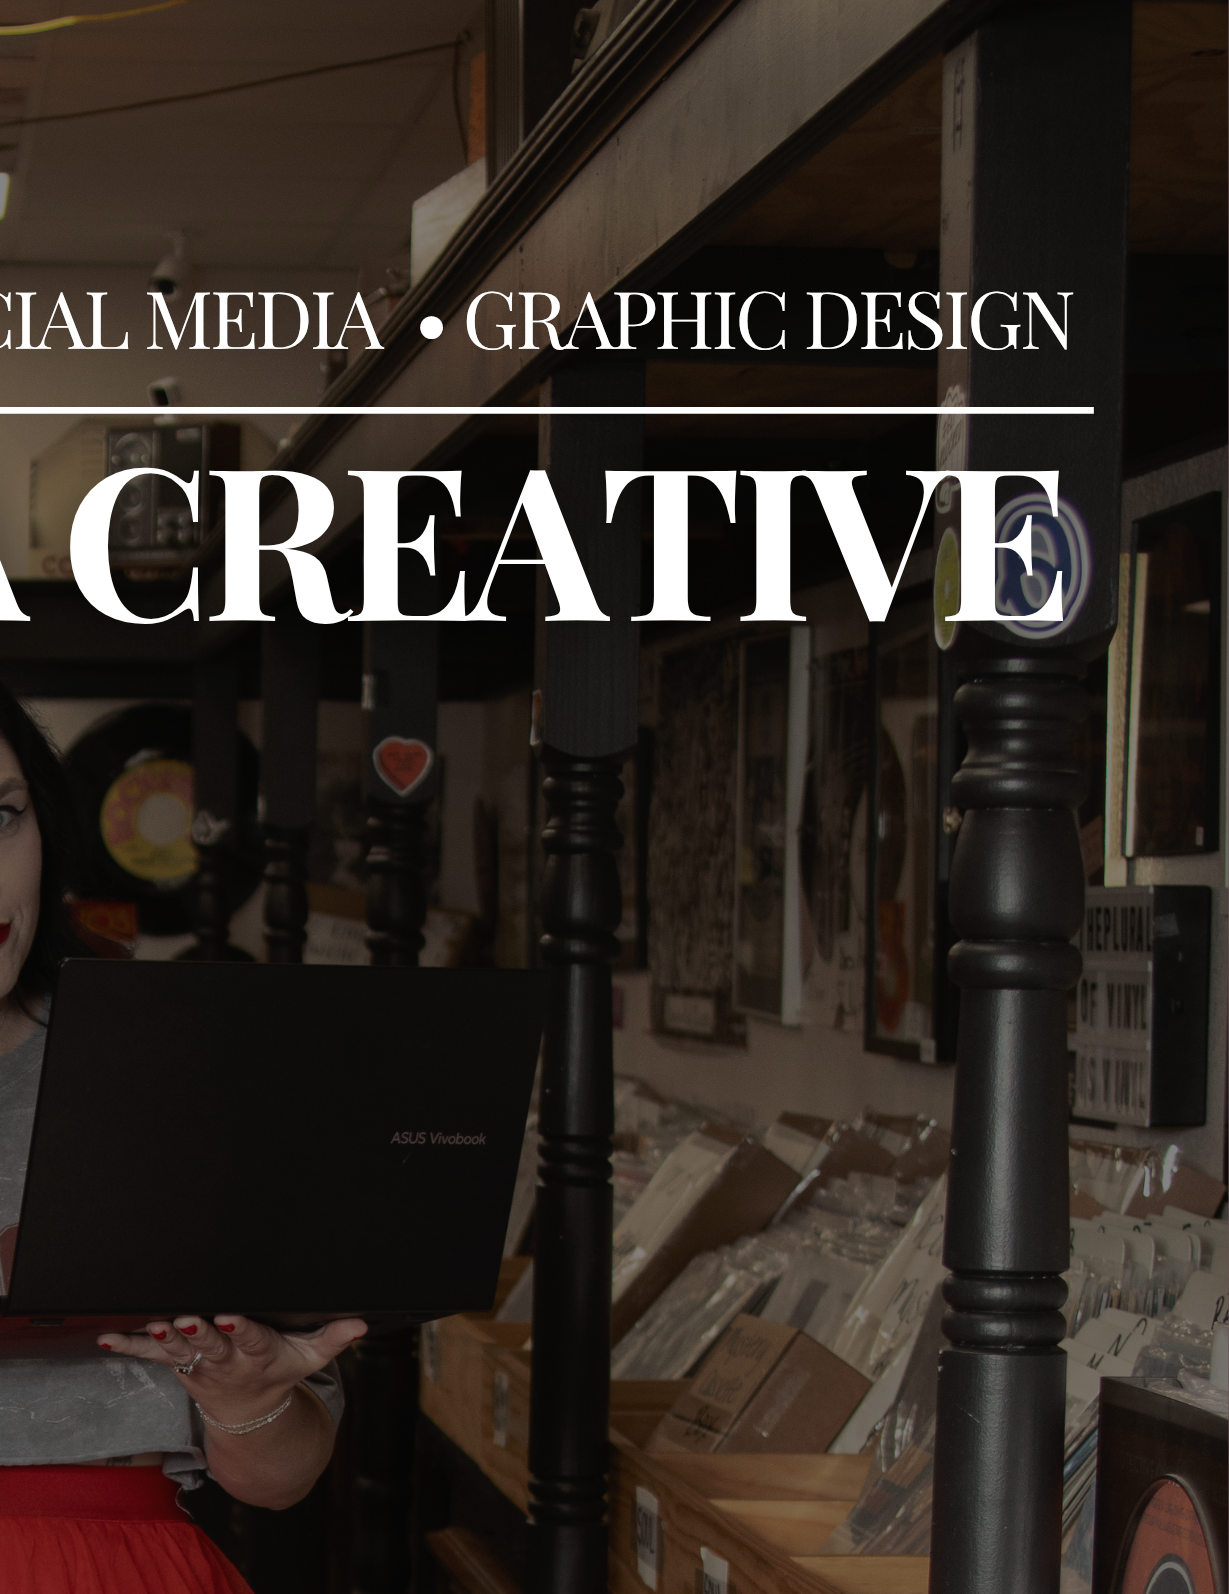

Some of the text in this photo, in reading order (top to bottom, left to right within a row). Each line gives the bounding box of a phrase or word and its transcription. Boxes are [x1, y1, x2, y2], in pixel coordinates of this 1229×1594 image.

[1106, 983, 1147, 1030] VINYL
[390, 1131, 487, 1146] ASUS Vivobook
